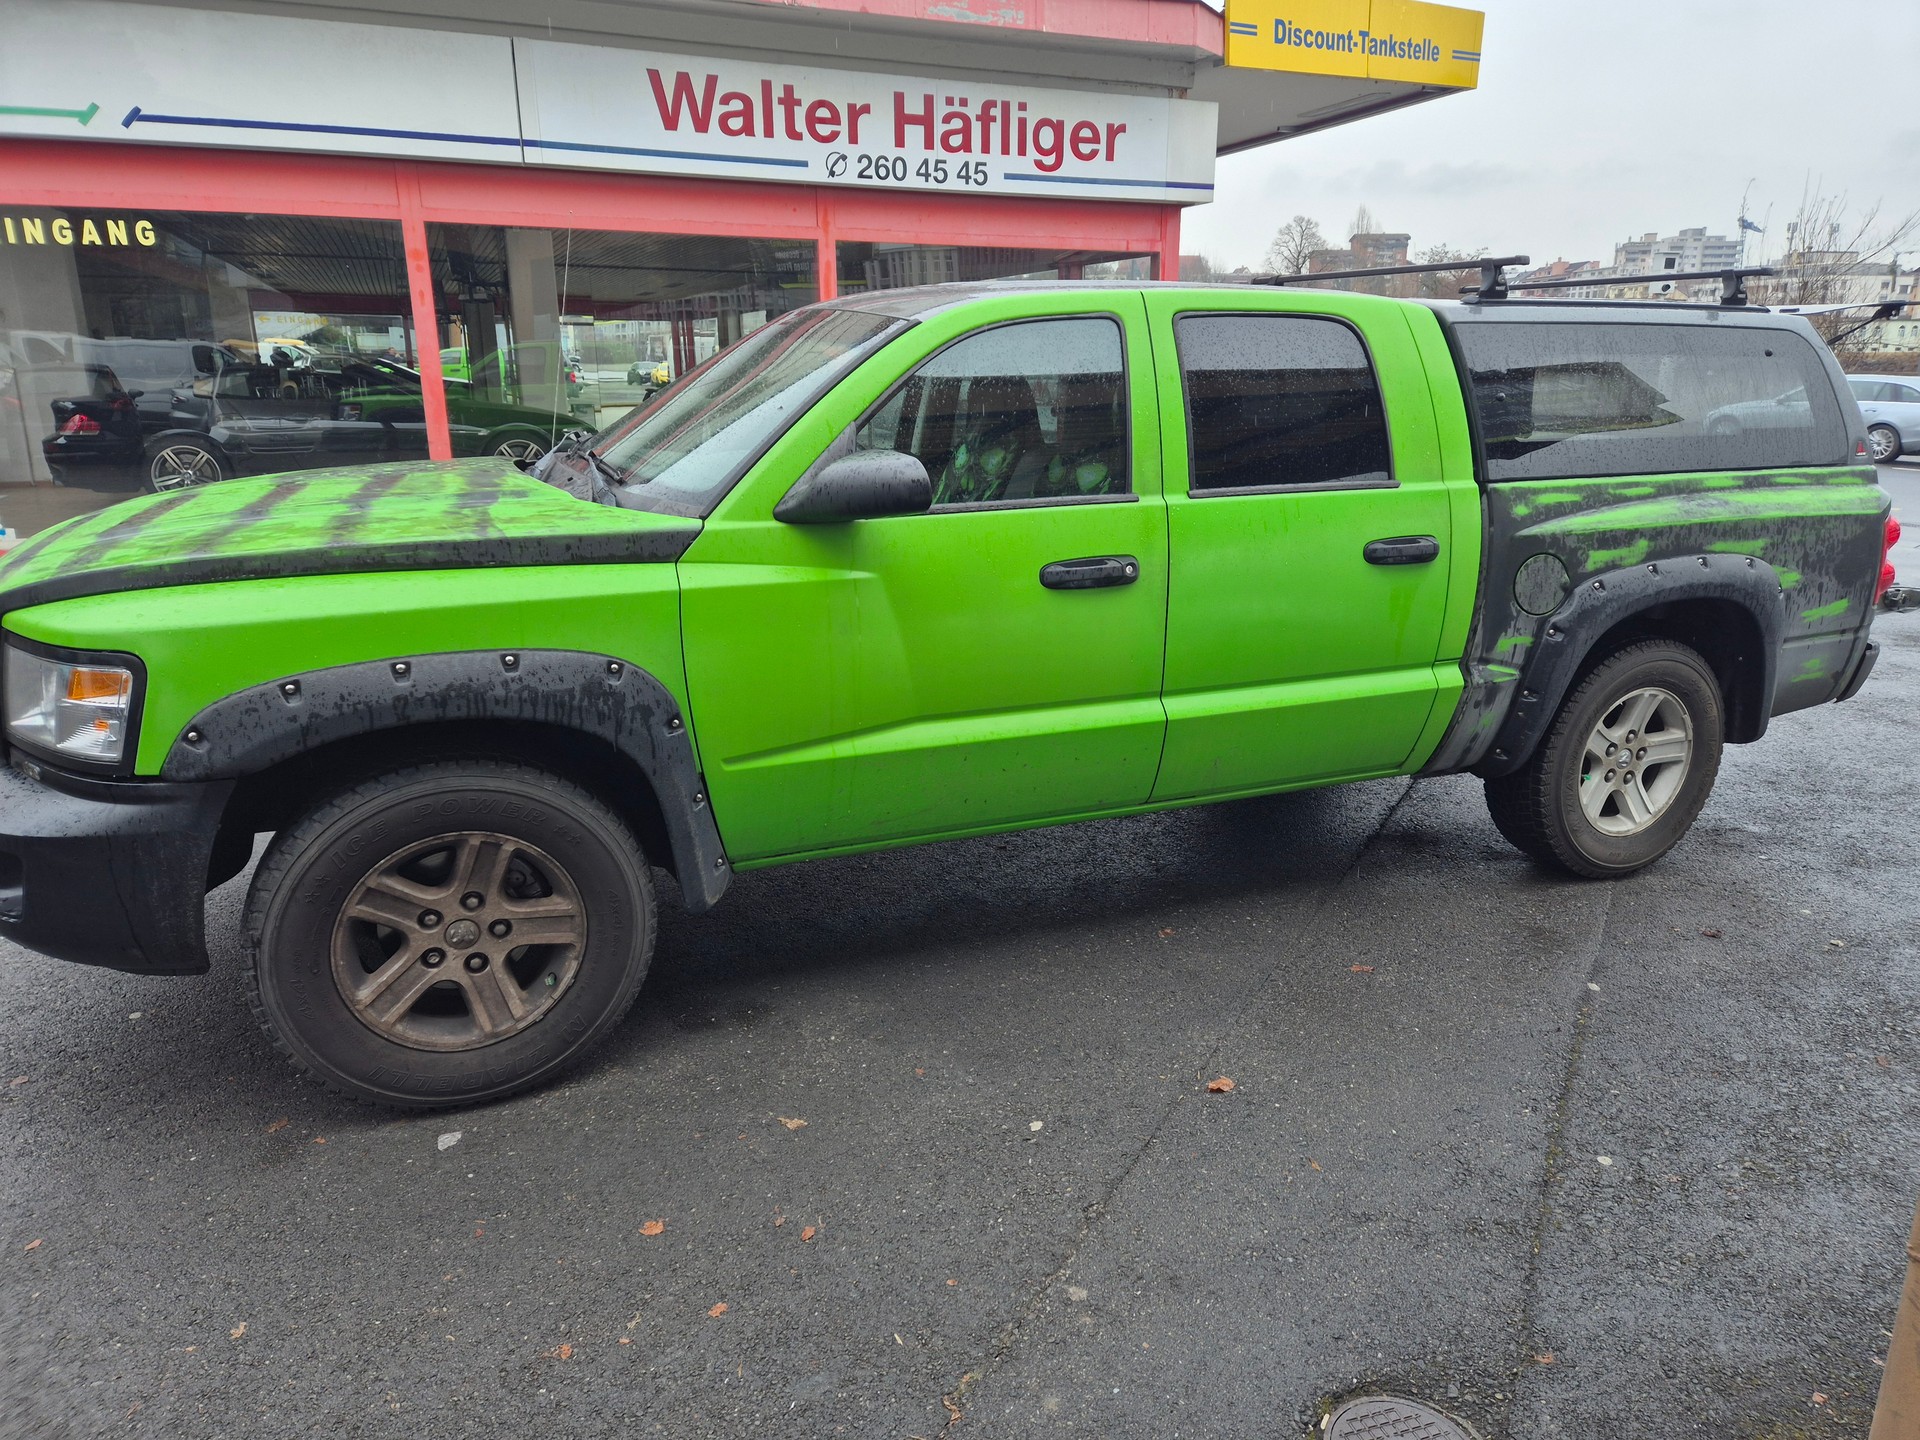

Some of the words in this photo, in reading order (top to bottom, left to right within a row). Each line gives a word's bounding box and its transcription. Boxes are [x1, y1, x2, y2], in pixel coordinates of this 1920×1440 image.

[1274, 18, 1440, 62] Discount-Tankstelle
[646, 68, 871, 145] Walter
[893, 91, 1127, 173] Häfliger
[857, 153, 908, 182] 260
[915, 157, 949, 184] 45
[956, 160, 989, 186] 45
[0, 217, 156, 246] INGANG
[330, 819, 389, 871] ICE
[413, 796, 548, 825] POWER
